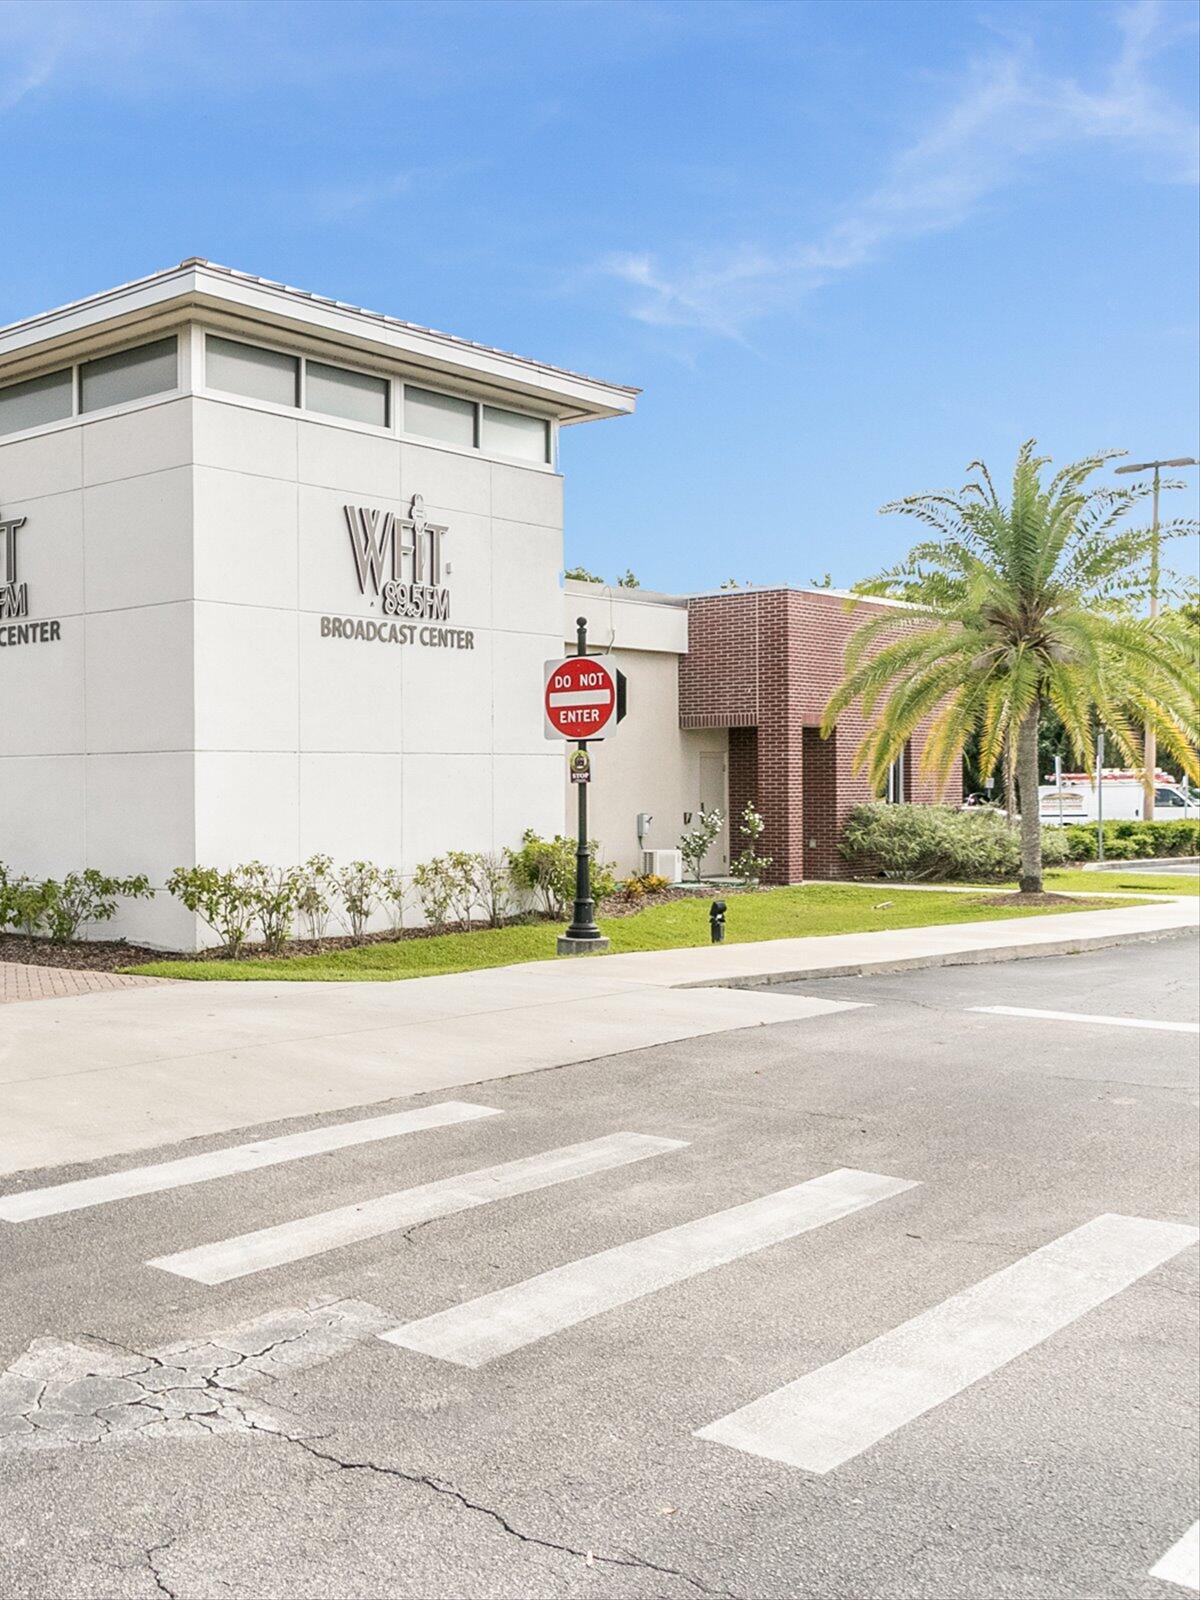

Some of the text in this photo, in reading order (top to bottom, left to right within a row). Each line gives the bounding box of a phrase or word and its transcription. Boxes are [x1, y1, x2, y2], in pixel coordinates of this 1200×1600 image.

[344, 504, 449, 596] WFIT
[383, 580, 450, 621] 89.5FM
[320, 616, 475, 650] BROADCAST CENTER
[554, 672, 604, 689] DO NOT
[559, 709, 600, 724] ENTER
